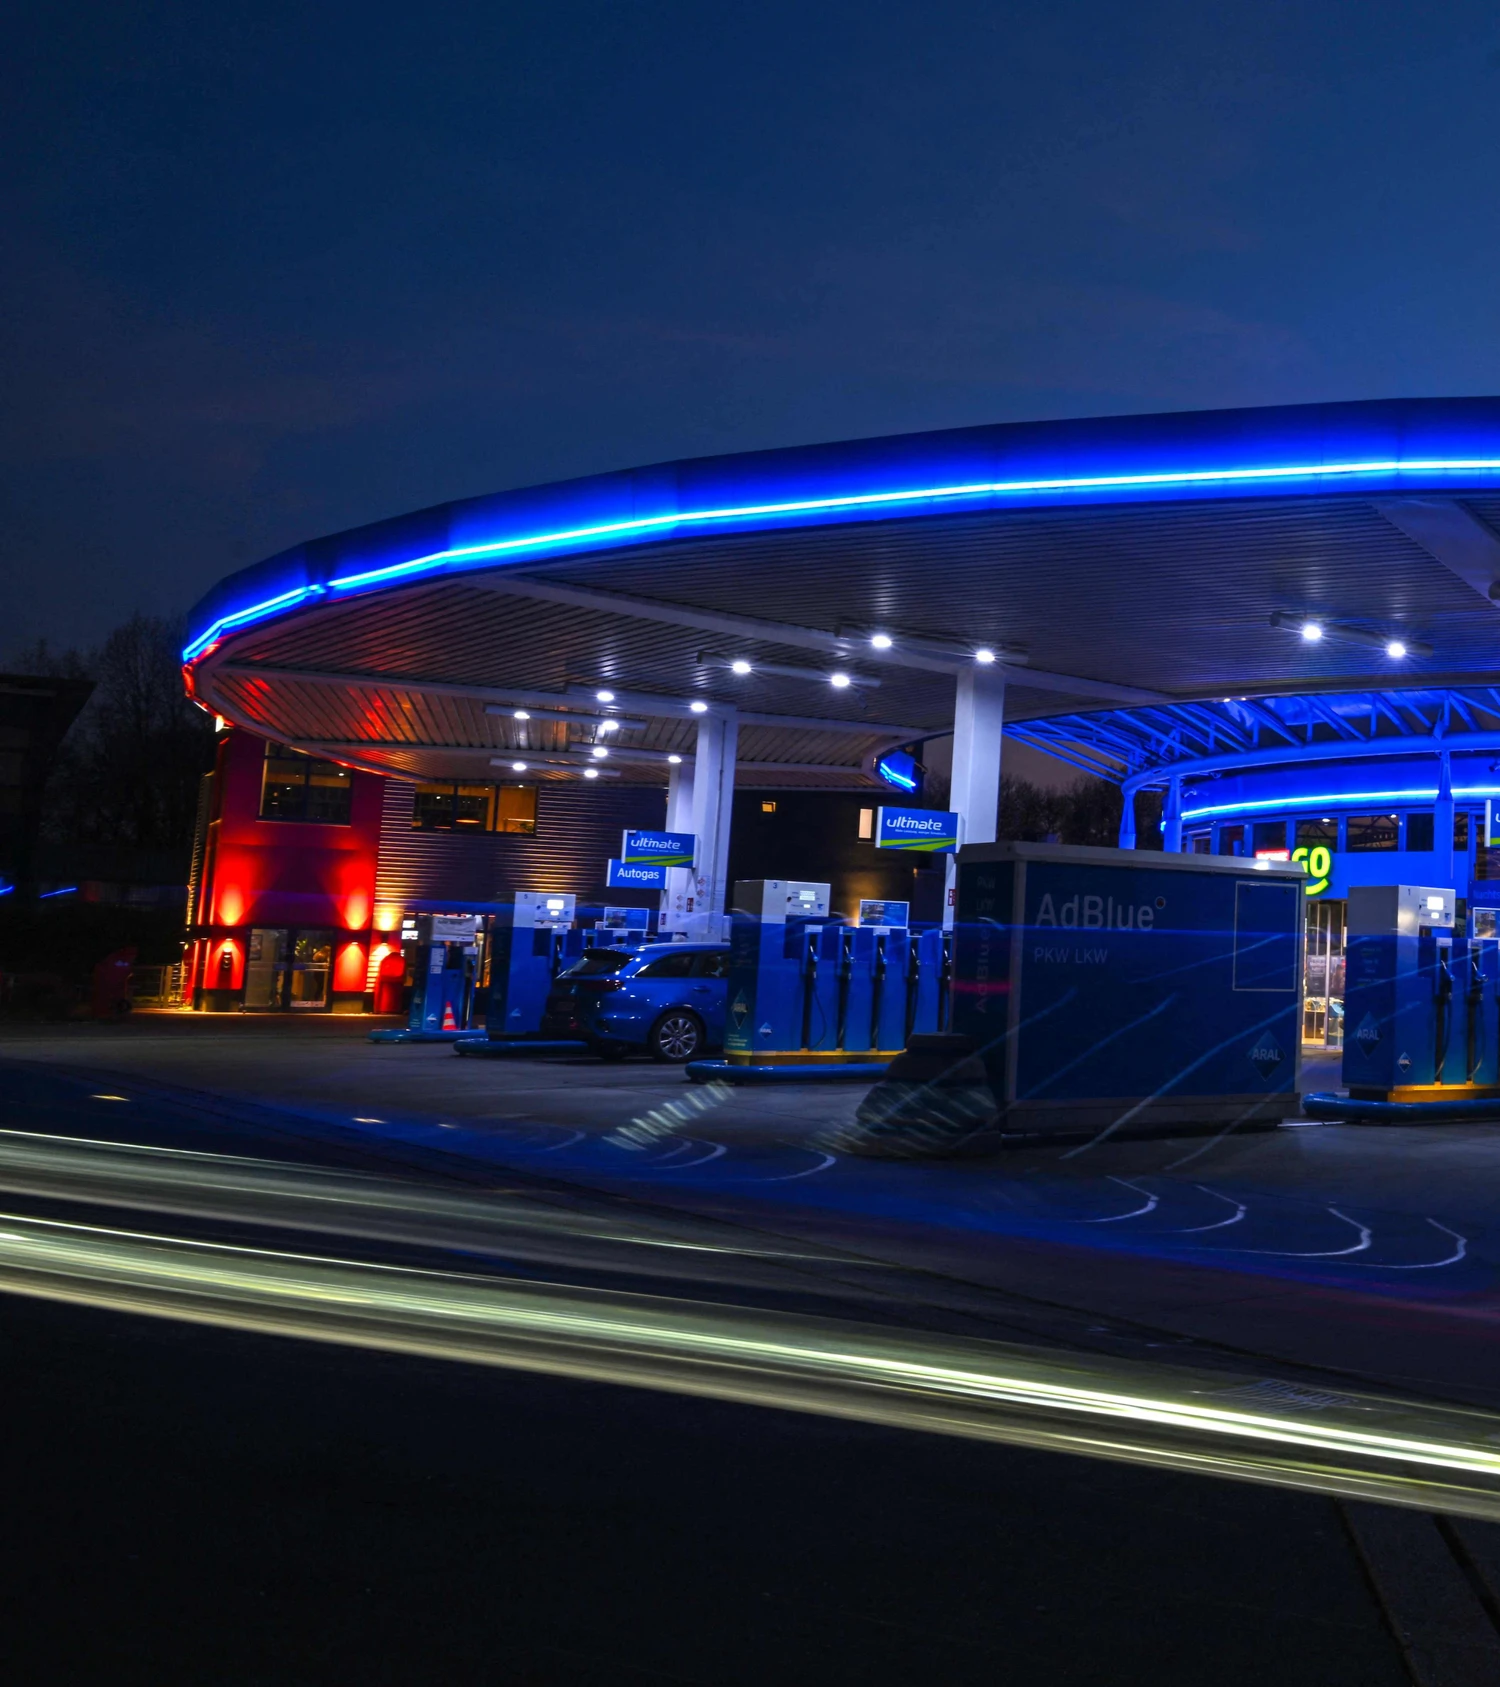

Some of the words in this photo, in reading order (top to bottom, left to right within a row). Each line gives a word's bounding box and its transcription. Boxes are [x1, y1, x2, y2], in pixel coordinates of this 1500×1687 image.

[886, 816, 943, 831] ultimate
[630, 837, 681, 850] ultimate
[617, 867, 660, 881] Autogas
[1034, 946, 1069, 964] PKW
[1075, 947, 1108, 965] LKW
[1356, 1028, 1380, 1041] ARAL
[1251, 1048, 1281, 1062] ARAL
